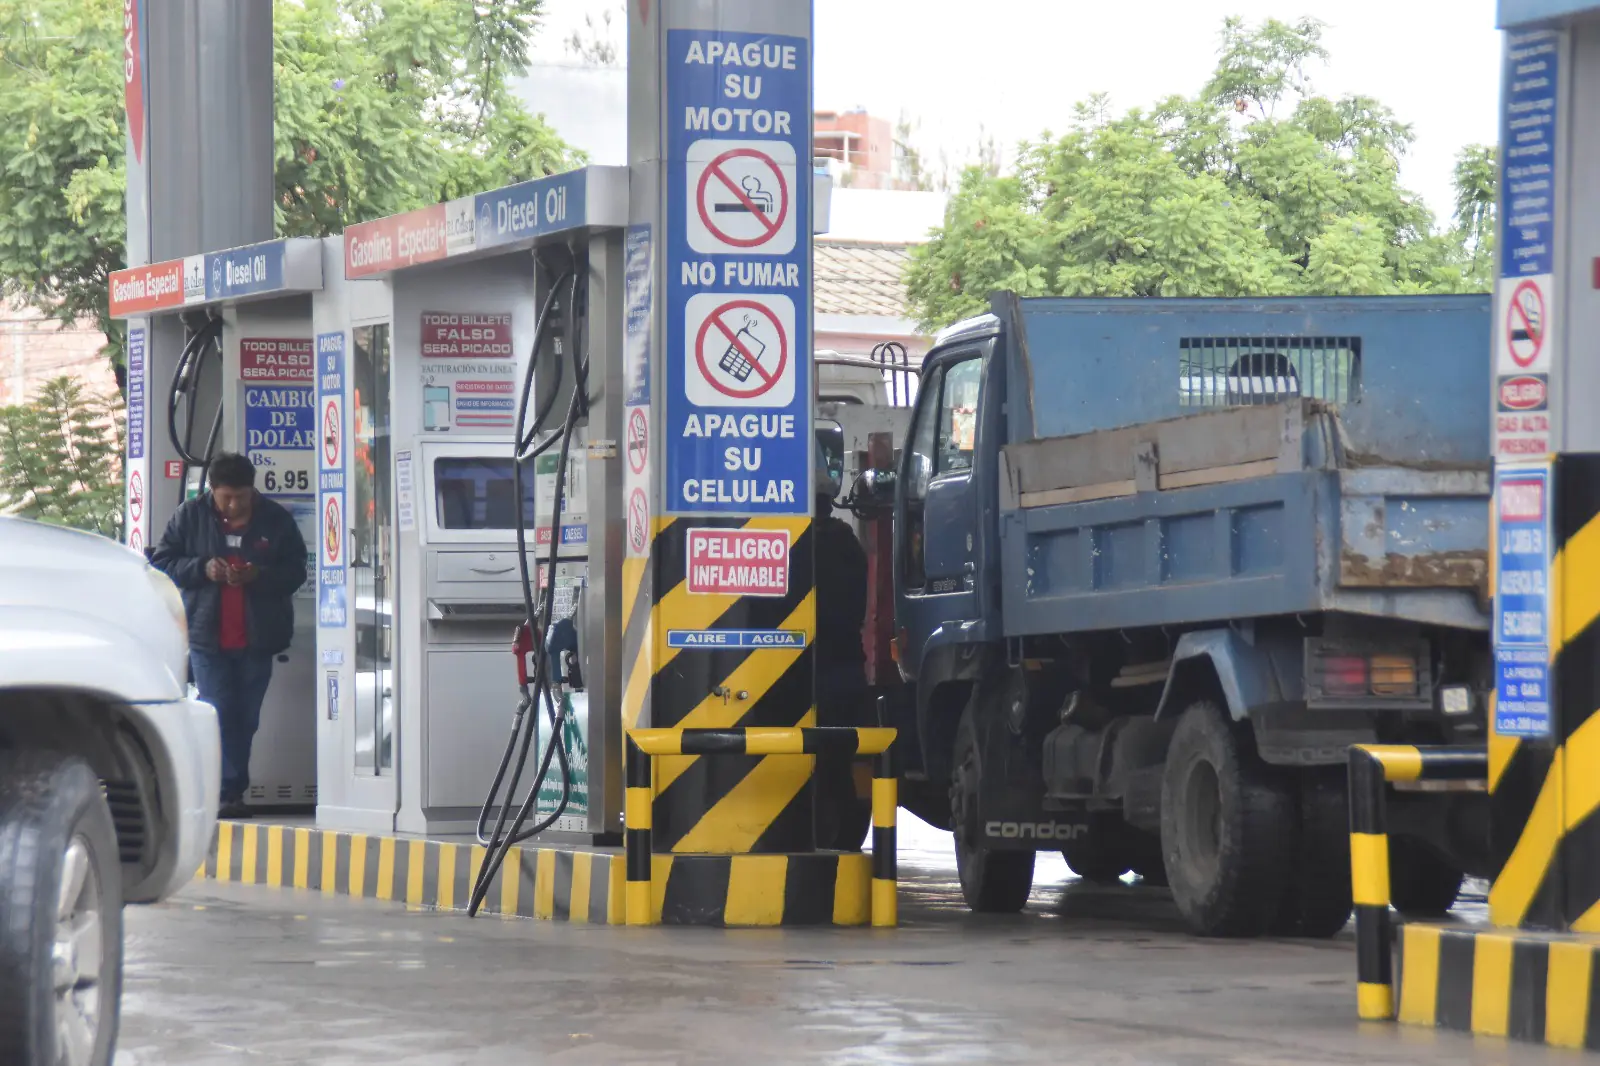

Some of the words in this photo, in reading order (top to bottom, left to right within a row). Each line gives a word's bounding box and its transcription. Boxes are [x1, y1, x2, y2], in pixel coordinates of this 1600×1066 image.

[684, 40, 797, 70] APAGUE
[724, 74, 762, 99] SU
[685, 106, 792, 135] MOTOR
[497, 192, 539, 235] Diesel
[545, 186, 566, 223] Oil
[350, 230, 392, 267] Gasolina
[226, 257, 252, 287] Diesel
[254, 255, 266, 281] Oil
[681, 261, 716, 286] NO
[724, 262, 799, 287] FUMAR
[113, 275, 145, 303] Gasolina
[146, 267, 179, 300] Especial
[424, 315, 458, 326] TODO
[461, 315, 511, 325] BILLETE
[437, 328, 495, 340] FALSO
[243, 341, 277, 352] TODO
[320, 336, 342, 353] APAGUE
[423, 341, 458, 353] SERÁ
[461, 343, 511, 354] PICADO
[256, 354, 310, 366] FALSO
[327, 356, 336, 371] SU
[478, 364, 488, 374] EN
[243, 365, 275, 378] SERÁ
[322, 374, 341, 390] MOTOR
[270, 411, 297, 427] DE
[683, 413, 795, 438] APAGUE
[253, 452, 276, 466] Bs.
[724, 447, 762, 471] SU
[264, 470, 309, 493] 6,95
[683, 478, 795, 503] CELULAR
[693, 537, 785, 560] PELIGRO
[321, 569, 344, 585] PELIGRO
[693, 564, 785, 587] INFLAMABLE
[684, 633, 726, 643] AIRE
[751, 634, 796, 644] AGUA
[985, 820, 1089, 839] condor
